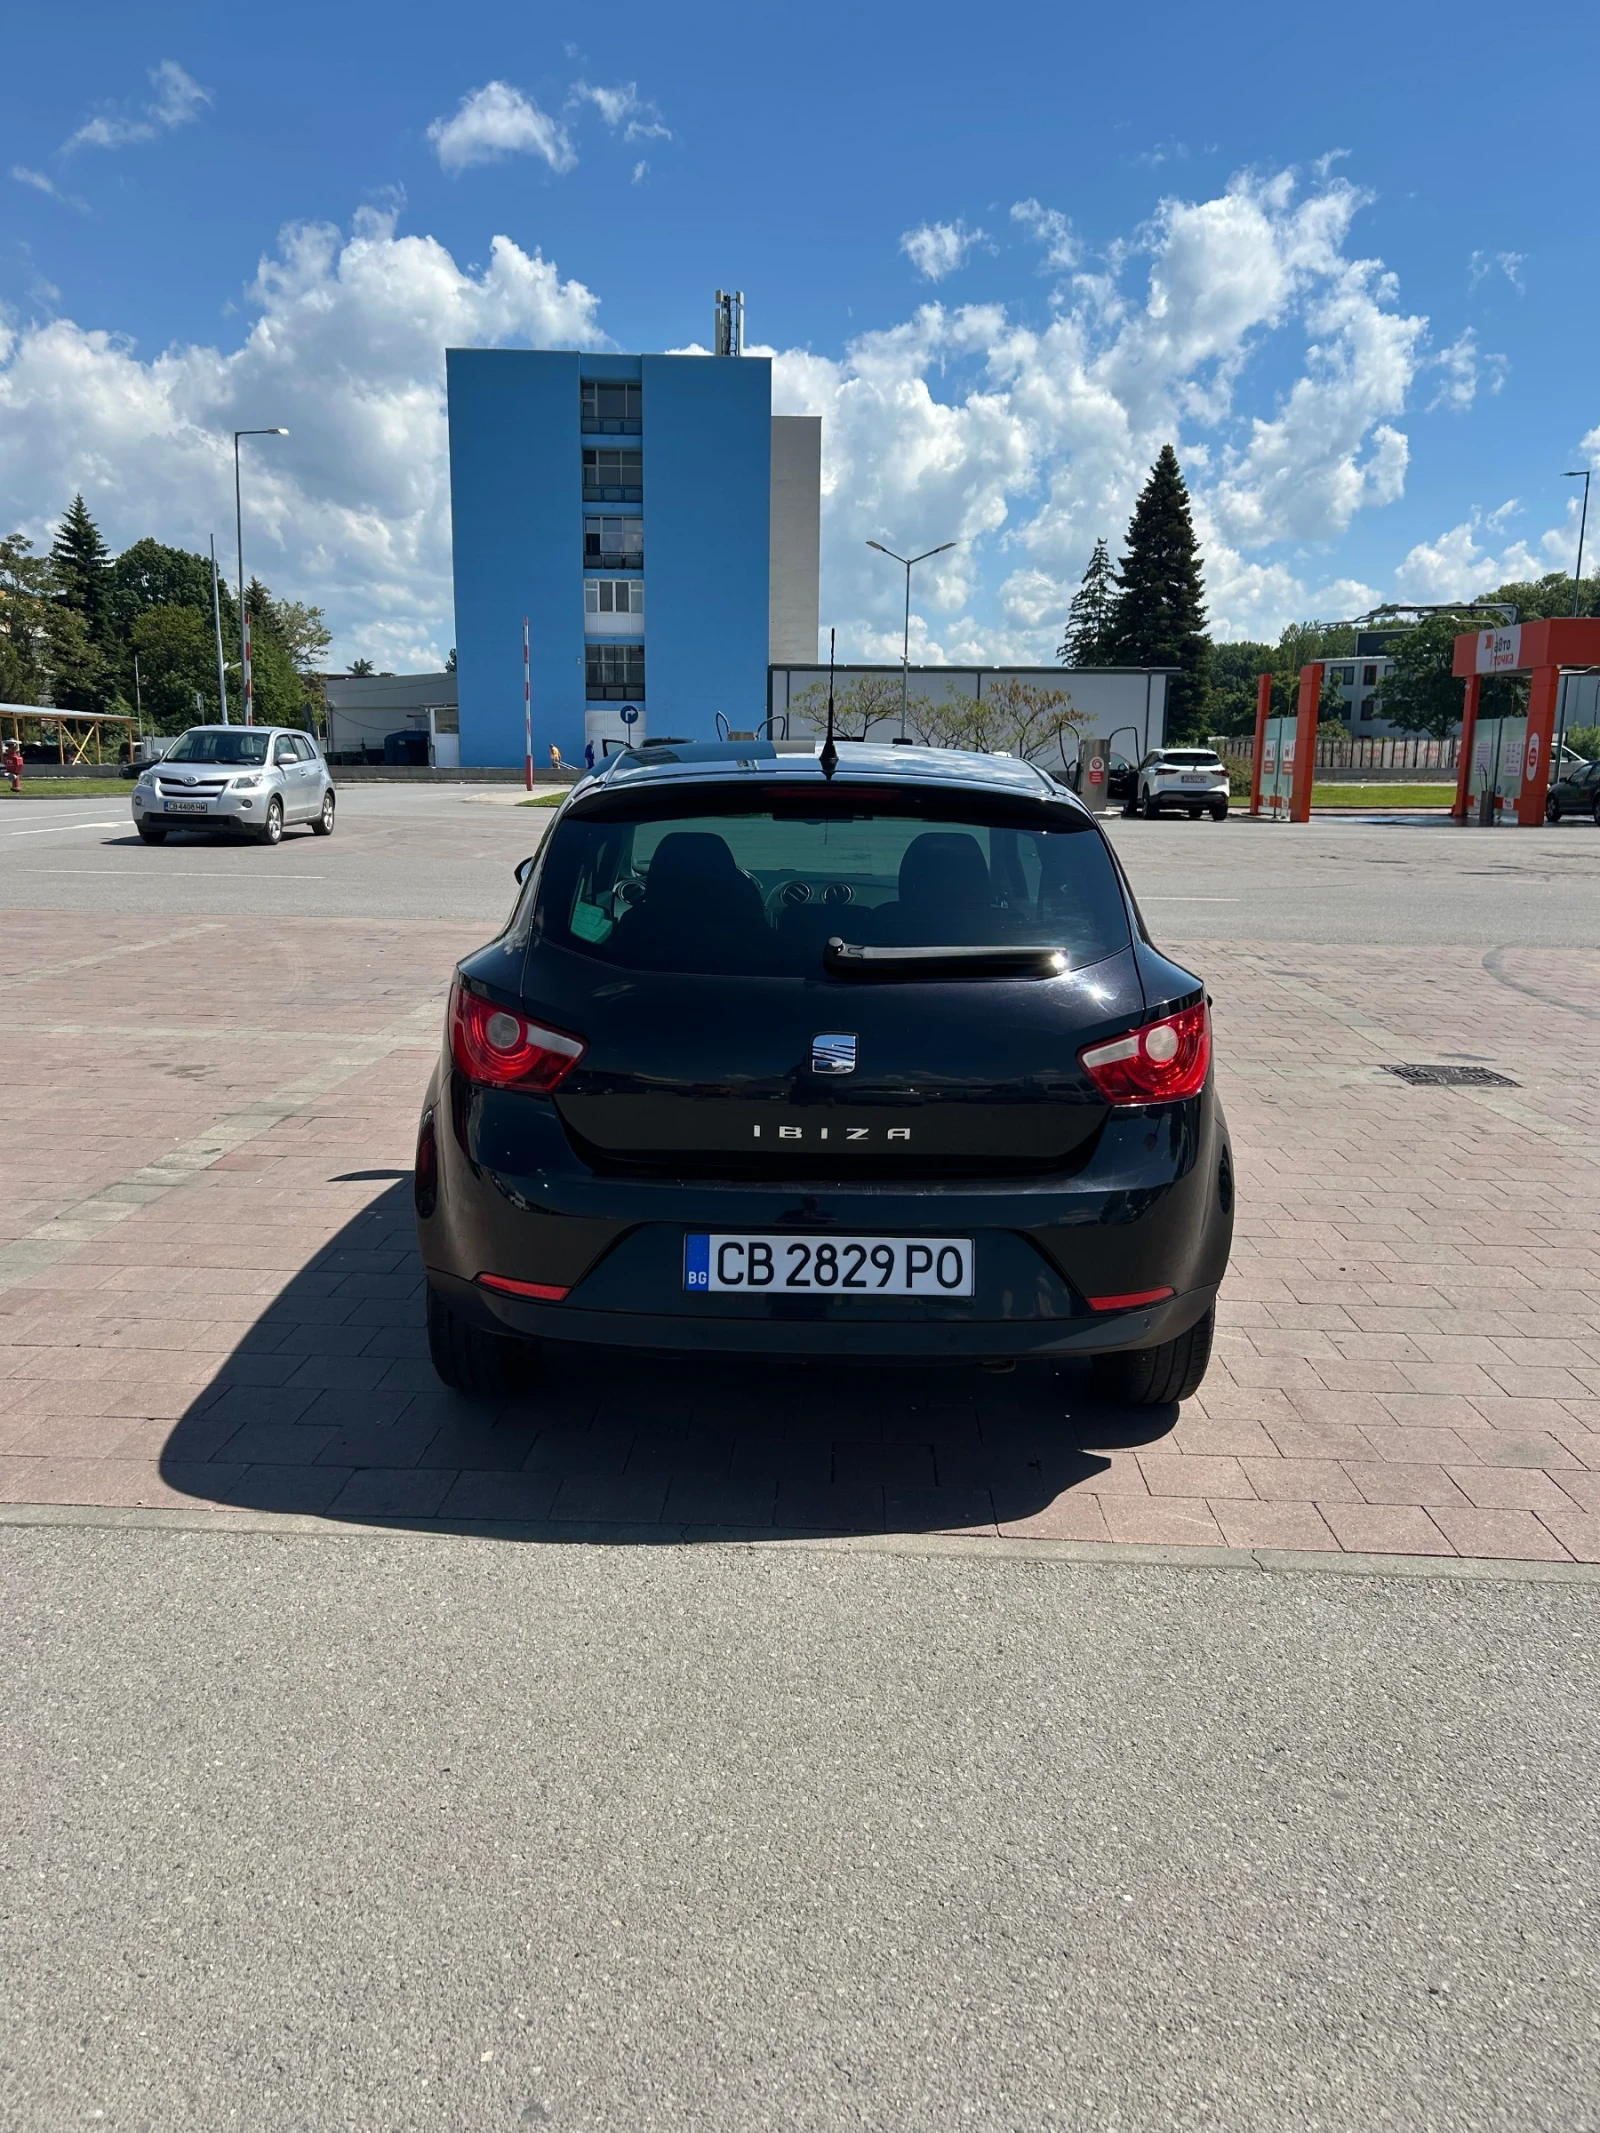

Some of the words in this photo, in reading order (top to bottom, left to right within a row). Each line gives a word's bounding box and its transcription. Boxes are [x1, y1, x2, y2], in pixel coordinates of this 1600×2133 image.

[753, 1124, 911, 1140] IBIZA
[717, 1241, 775, 1286] CB
[785, 1243, 895, 1288] 2829
[906, 1244, 963, 1289] PO
[688, 1271, 707, 1285] BG
